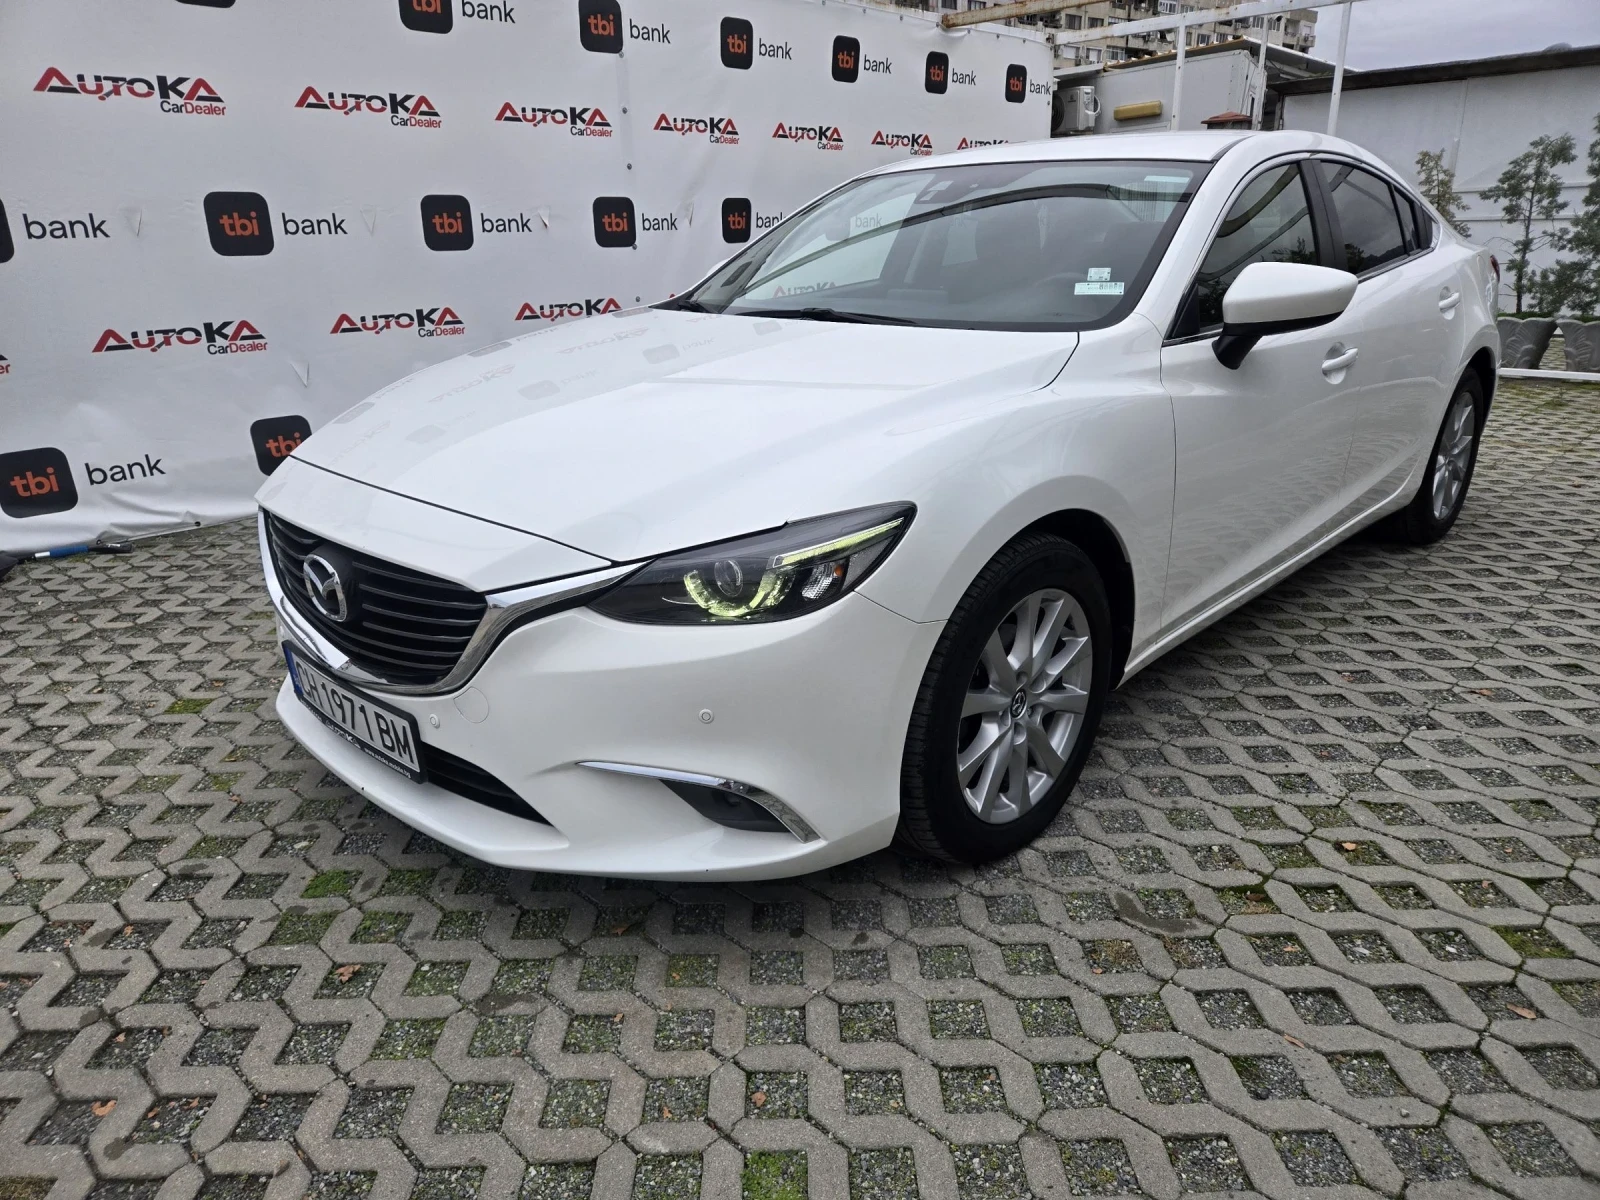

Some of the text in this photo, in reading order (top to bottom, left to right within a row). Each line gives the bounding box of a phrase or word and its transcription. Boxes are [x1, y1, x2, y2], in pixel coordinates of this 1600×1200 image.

[461, 0, 516, 24] bank
[588, 14, 671, 44] tbi bank
[727, 34, 793, 61] tbi bank
[837, 51, 893, 75] tbi bank
[930, 66, 977, 86] tbi bank
[1009, 76, 1052, 96] tbi bank
[22, 212, 111, 240] bank
[219, 211, 348, 236] tbi bank
[432, 212, 533, 234] tbi bank
[602, 212, 678, 232] tbi bank
[728, 211, 746, 229] tbi
[855, 212, 882, 228] bank
[10, 453, 167, 497] tbi bank
